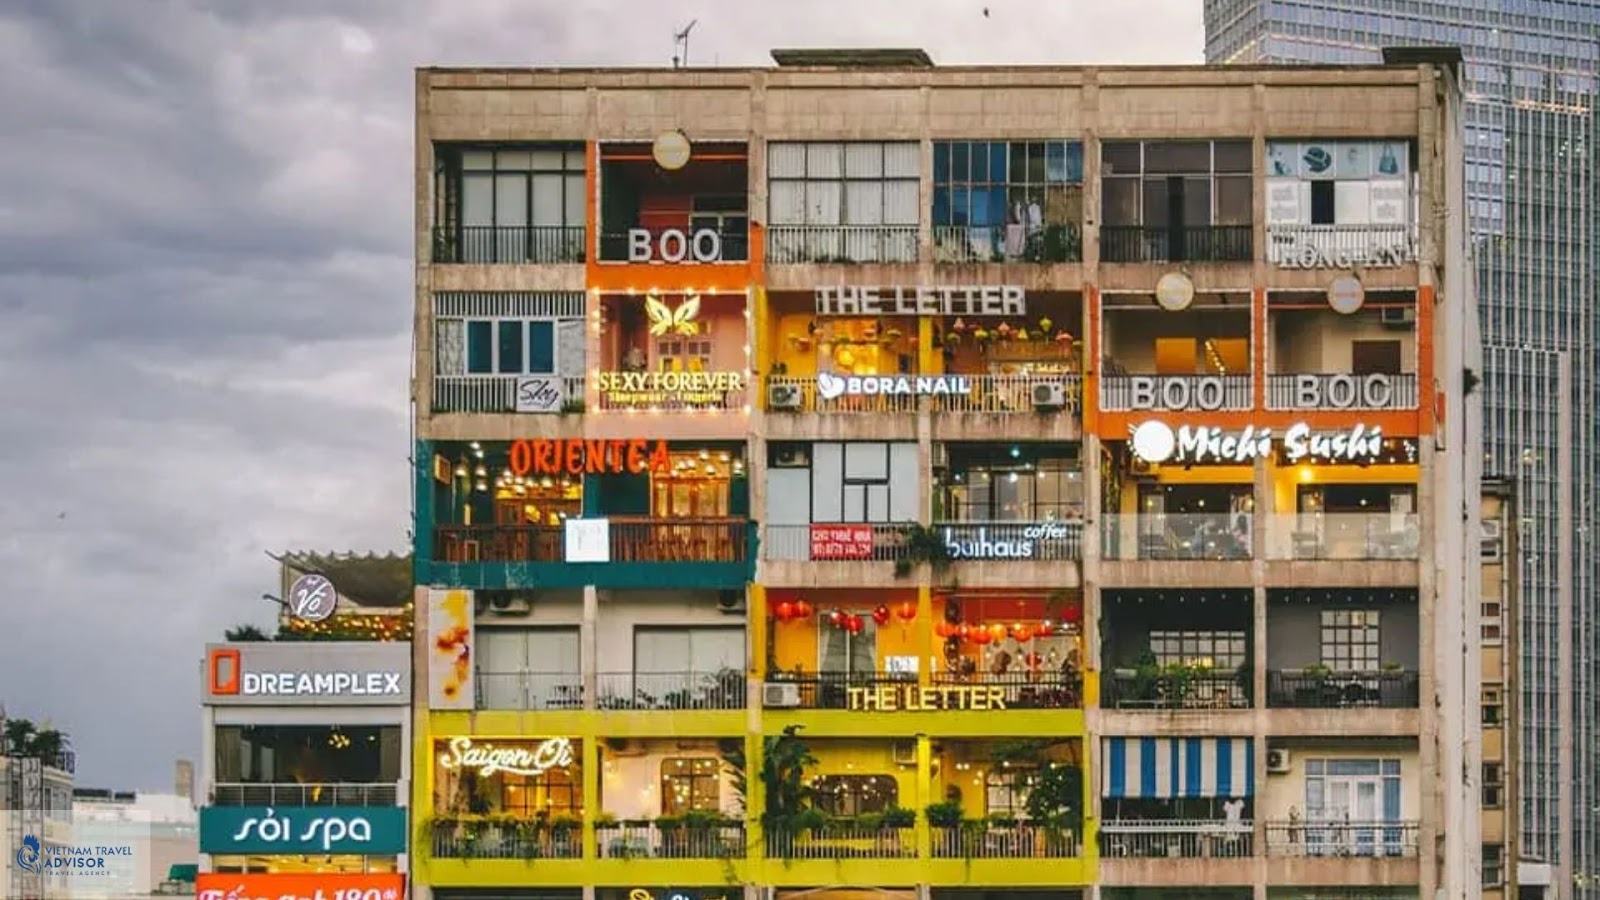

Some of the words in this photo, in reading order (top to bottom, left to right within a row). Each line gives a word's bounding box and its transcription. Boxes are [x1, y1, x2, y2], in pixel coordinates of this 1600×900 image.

[628, 228, 721, 263] BOO
[816, 286, 882, 315] THE
[895, 286, 1026, 315] LETTER
[599, 371, 649, 391] SEXY
[652, 371, 742, 391] FOREVER
[847, 377, 912, 395] BORA
[915, 377, 971, 395] NAIL
[1131, 376, 1225, 410] BOO
[1177, 424, 1272, 461] Michi
[1283, 422, 1382, 459] Sushi
[243, 673, 401, 695] DREAMPLEX
[848, 687, 897, 711] THE
[905, 687, 1007, 711] LETTER
[440, 736, 533, 777] Saigon
[301, 817, 372, 850] spa
